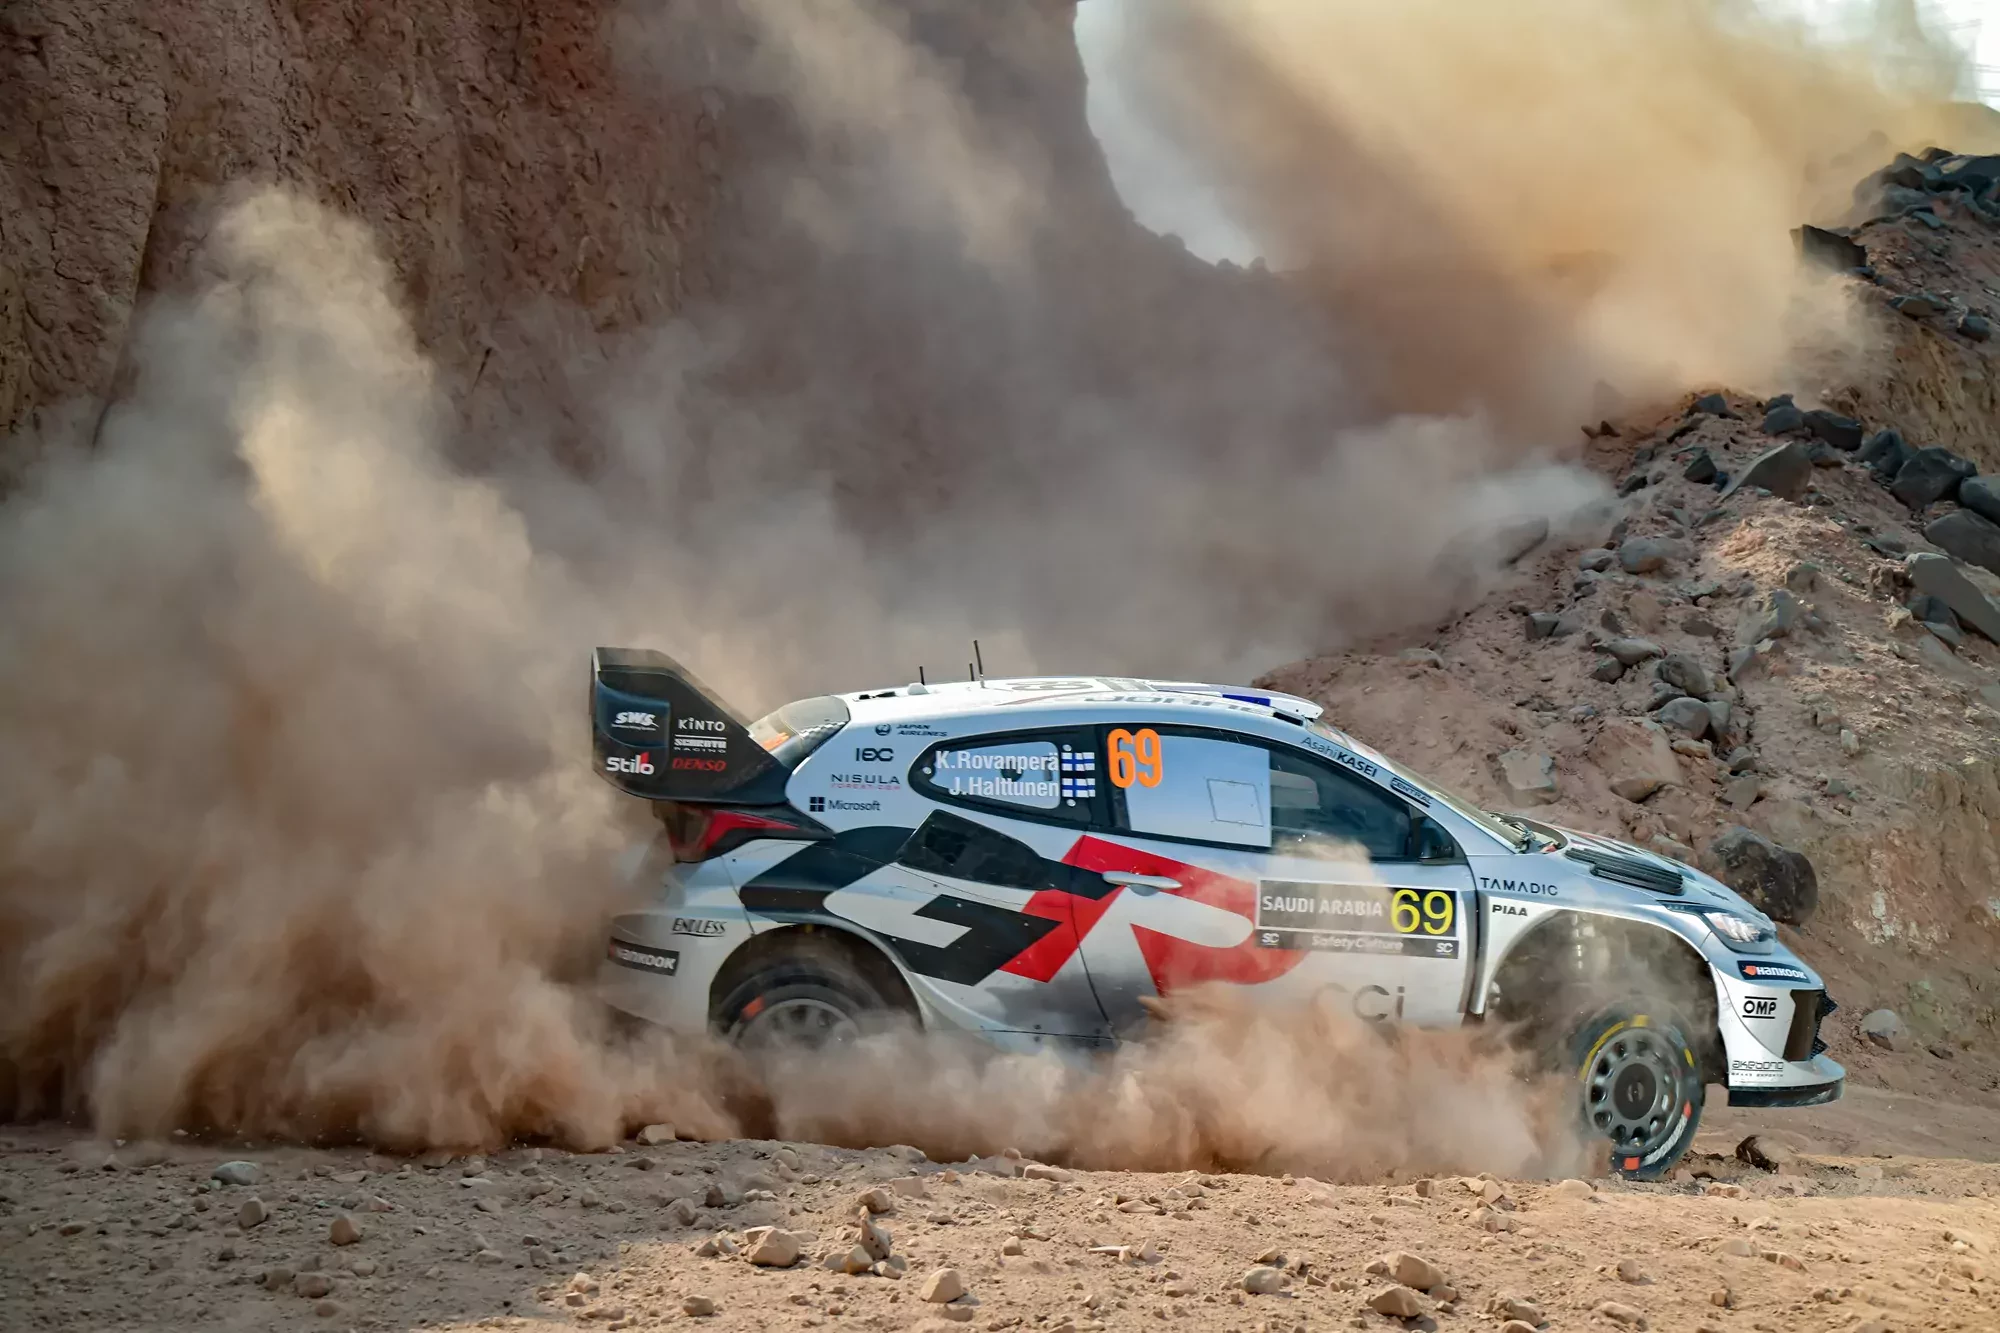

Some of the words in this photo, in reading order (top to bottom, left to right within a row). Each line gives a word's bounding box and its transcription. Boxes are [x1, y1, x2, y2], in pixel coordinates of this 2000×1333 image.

[614, 711, 659, 727] SWS
[606, 752, 654, 775] Stilo
[672, 757, 727, 772] DENSO
[935, 750, 1059, 774] K.Rovanperä
[1107, 728, 1163, 789] 69
[831, 773, 901, 785] NISULA
[948, 776, 1059, 797] J.Halttunen
[828, 799, 881, 811] Microsoft
[1480, 877, 1558, 896] TAMADIC
[1262, 895, 1314, 914] SAUDI
[1318, 898, 1384, 917] ARABIA
[1391, 888, 1454, 935] 69
[1492, 904, 1528, 917] PIAA
[1261, 932, 1280, 945] SC
[1435, 941, 1454, 954] SC
[1743, 1000, 1777, 1015] OMP
